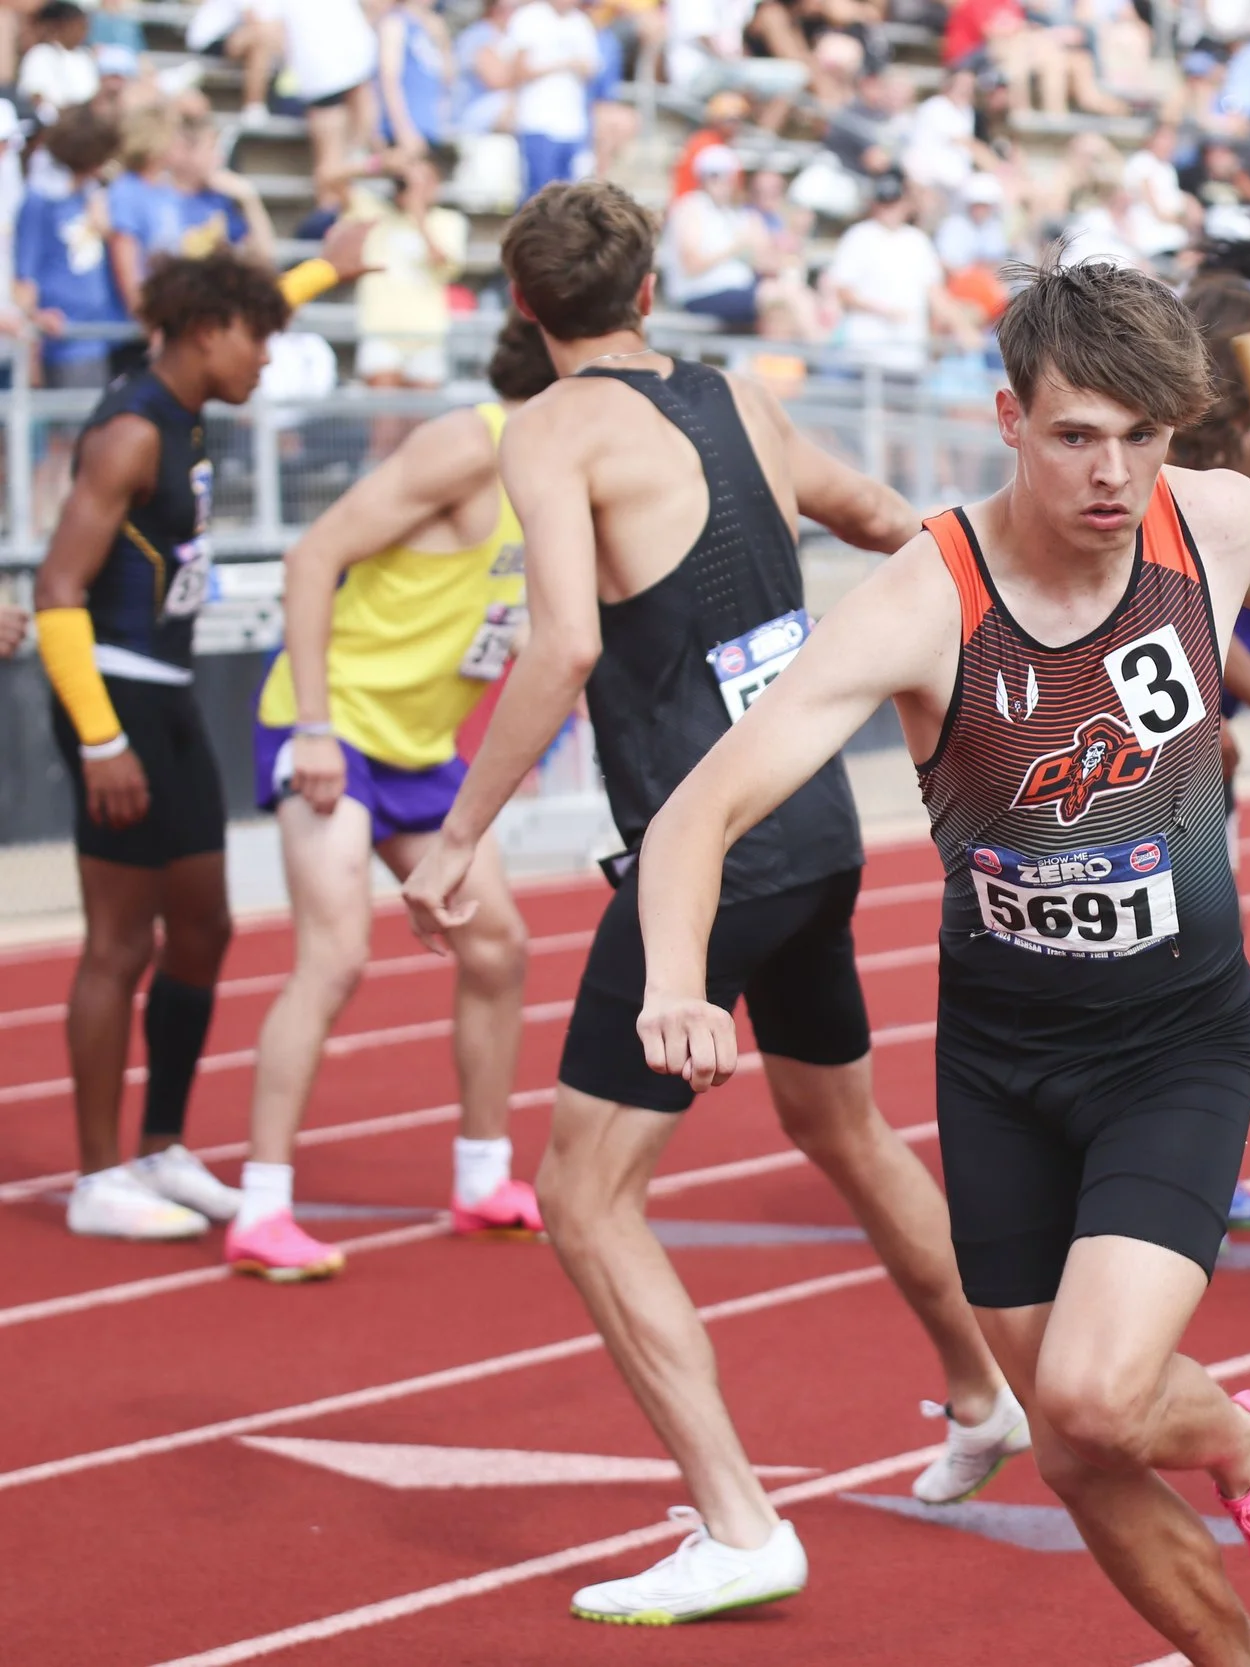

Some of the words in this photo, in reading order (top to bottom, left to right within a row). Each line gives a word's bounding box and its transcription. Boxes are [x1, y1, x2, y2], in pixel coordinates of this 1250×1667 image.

[1120, 642, 1190, 734] 3
[1017, 857, 1113, 884] ZERO
[1037, 852, 1089, 867] SHOW-ME
[986, 882, 1154, 943] 5691
